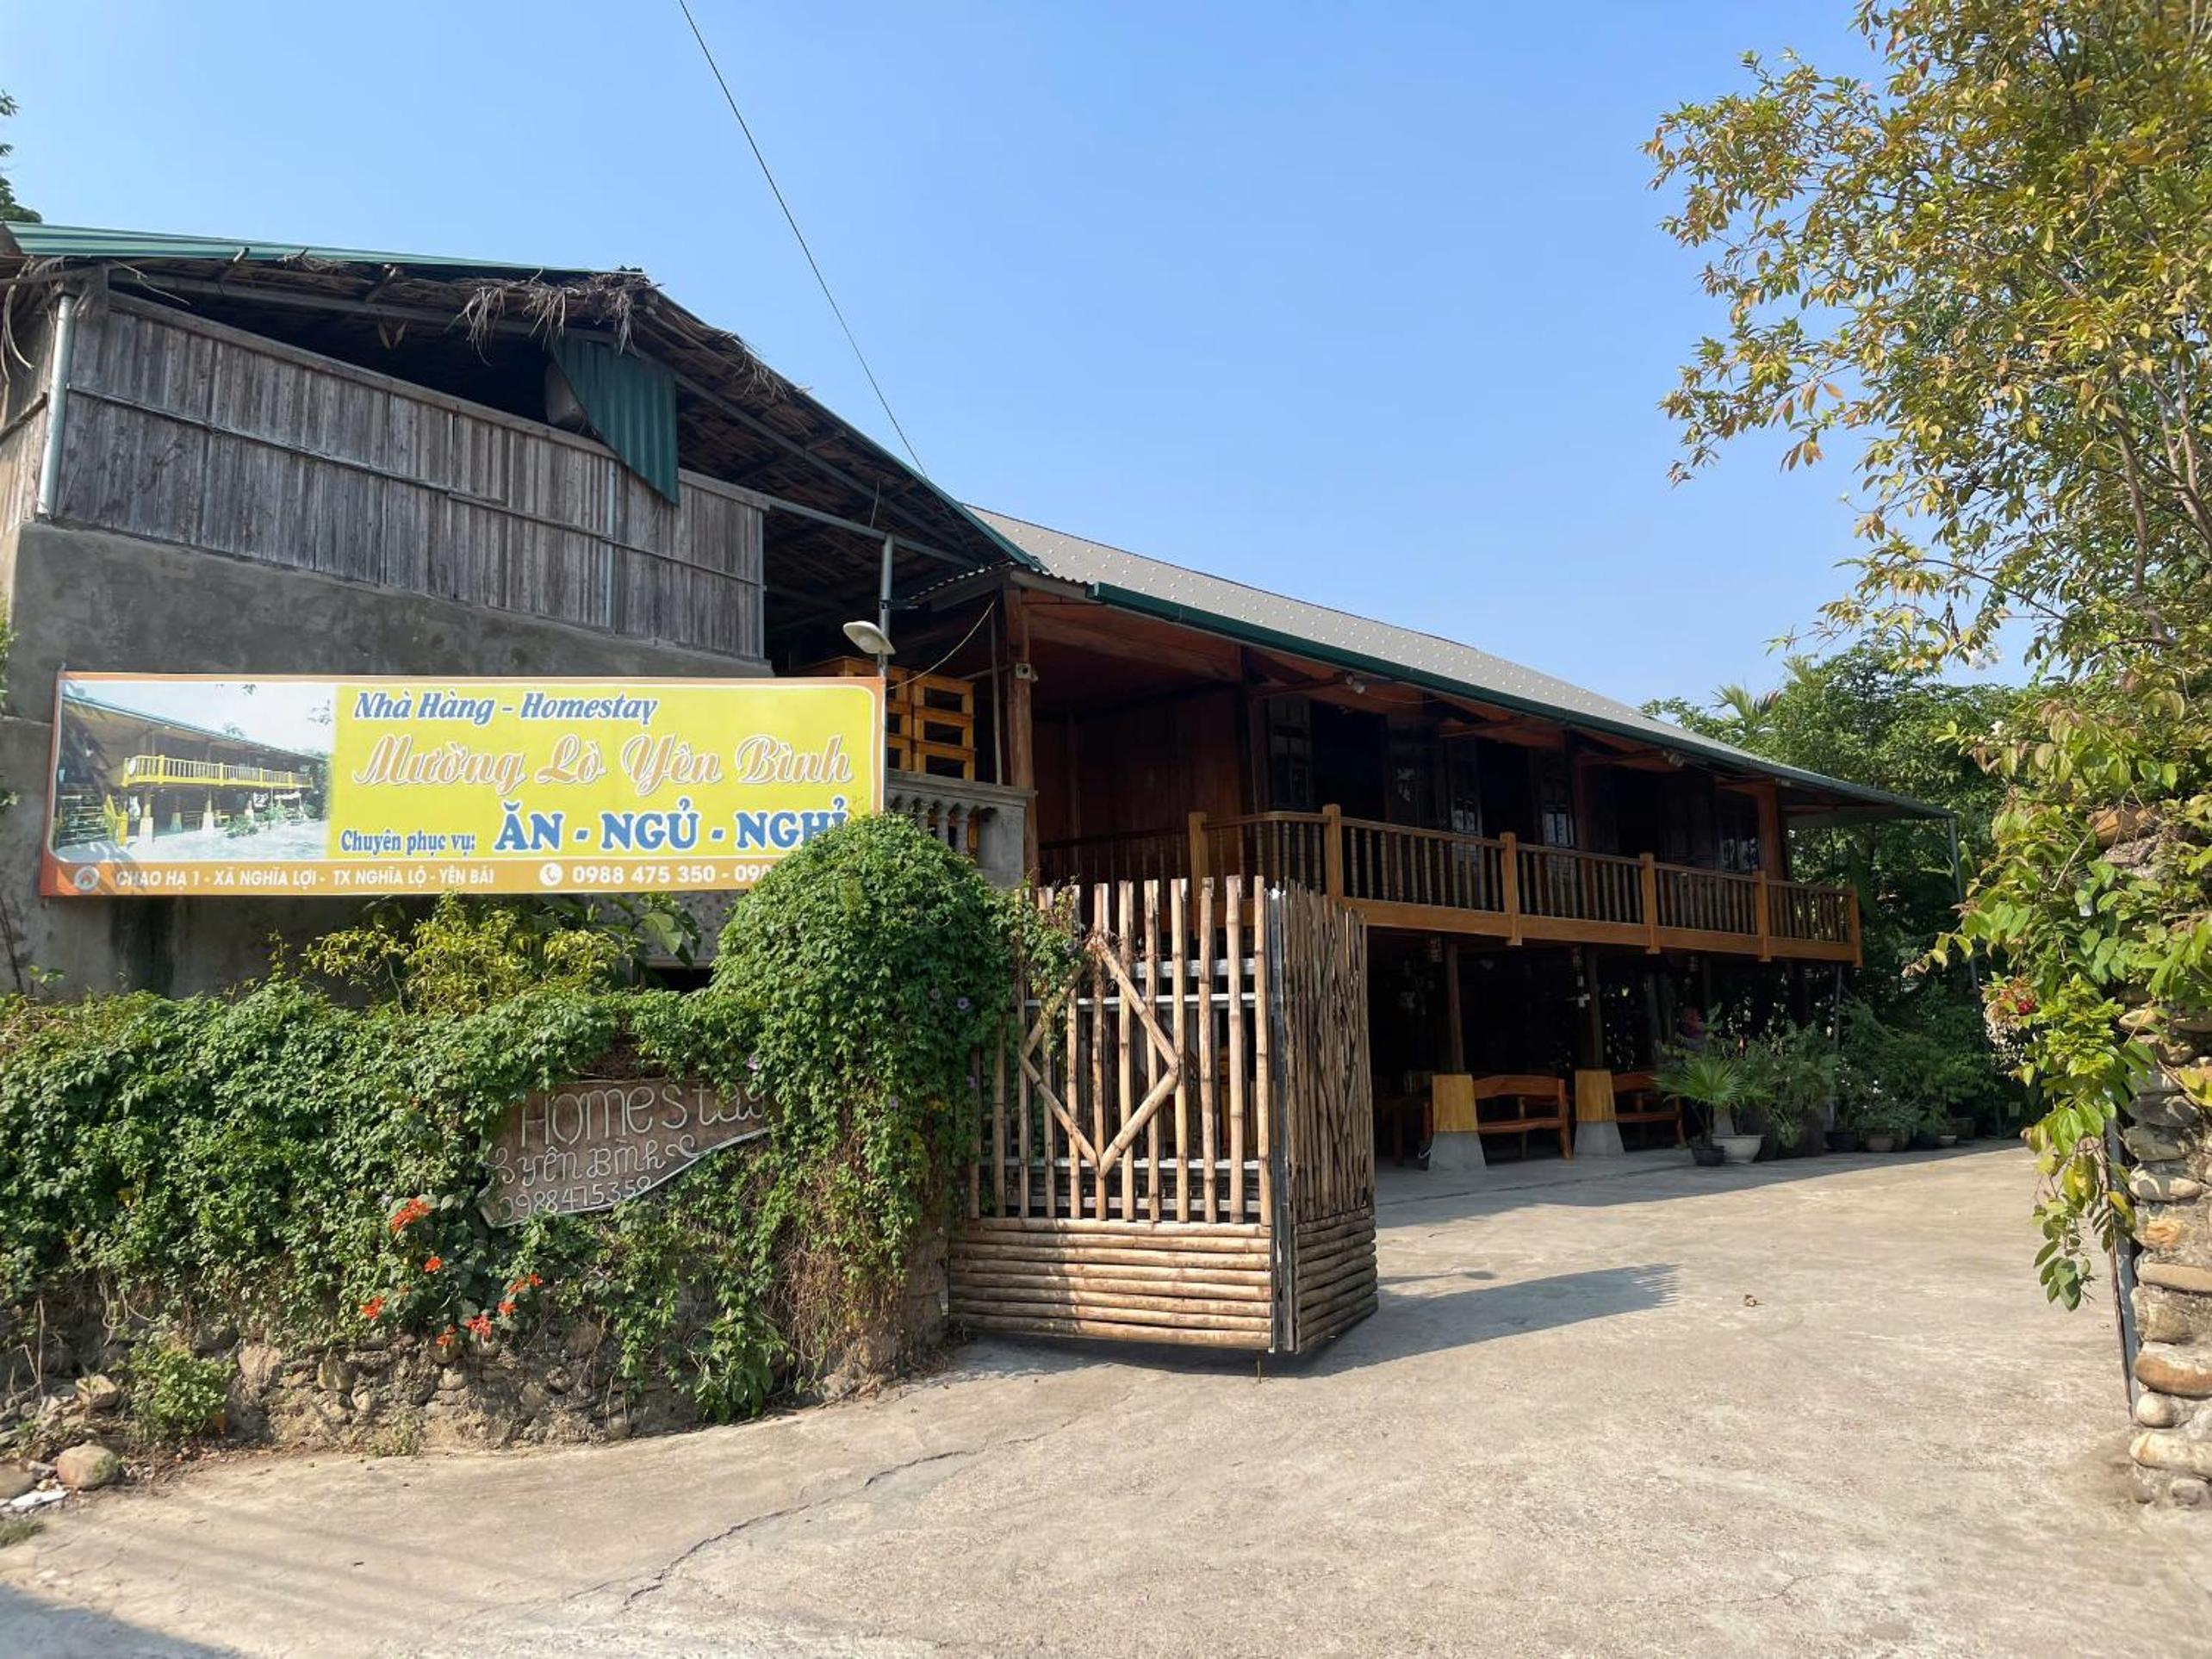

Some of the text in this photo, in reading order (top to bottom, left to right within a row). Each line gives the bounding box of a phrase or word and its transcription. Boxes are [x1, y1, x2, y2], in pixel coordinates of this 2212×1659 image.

[354, 692, 411, 719] Nhà
[419, 693, 494, 725] Hàng
[519, 692, 658, 725] Homestay
[352, 733, 854, 796] Mường Lò Yên Bình
[494, 801, 563, 850] ĂN
[600, 798, 700, 849] NGỦ
[340, 829, 402, 856] Chuyên
[406, 830, 446, 856] phục
[116, 870, 162, 886] CHAO
[165, 870, 187, 891] HẠ
[191, 871, 200, 885] 1
[214, 866, 234, 885] XÃ
[239, 866, 289, 885] NGHĨA
[293, 868, 316, 890] LỢI
[333, 870, 351, 885] TX
[355, 866, 404, 885] NGHĨA
[408, 865, 427, 888] LỘ
[439, 864, 466, 885] YÊN
[470, 864, 494, 884] BÁI
[572, 866, 624, 884] 0988
[631, 866, 671, 884] 475
[677, 865, 716, 883] 350
